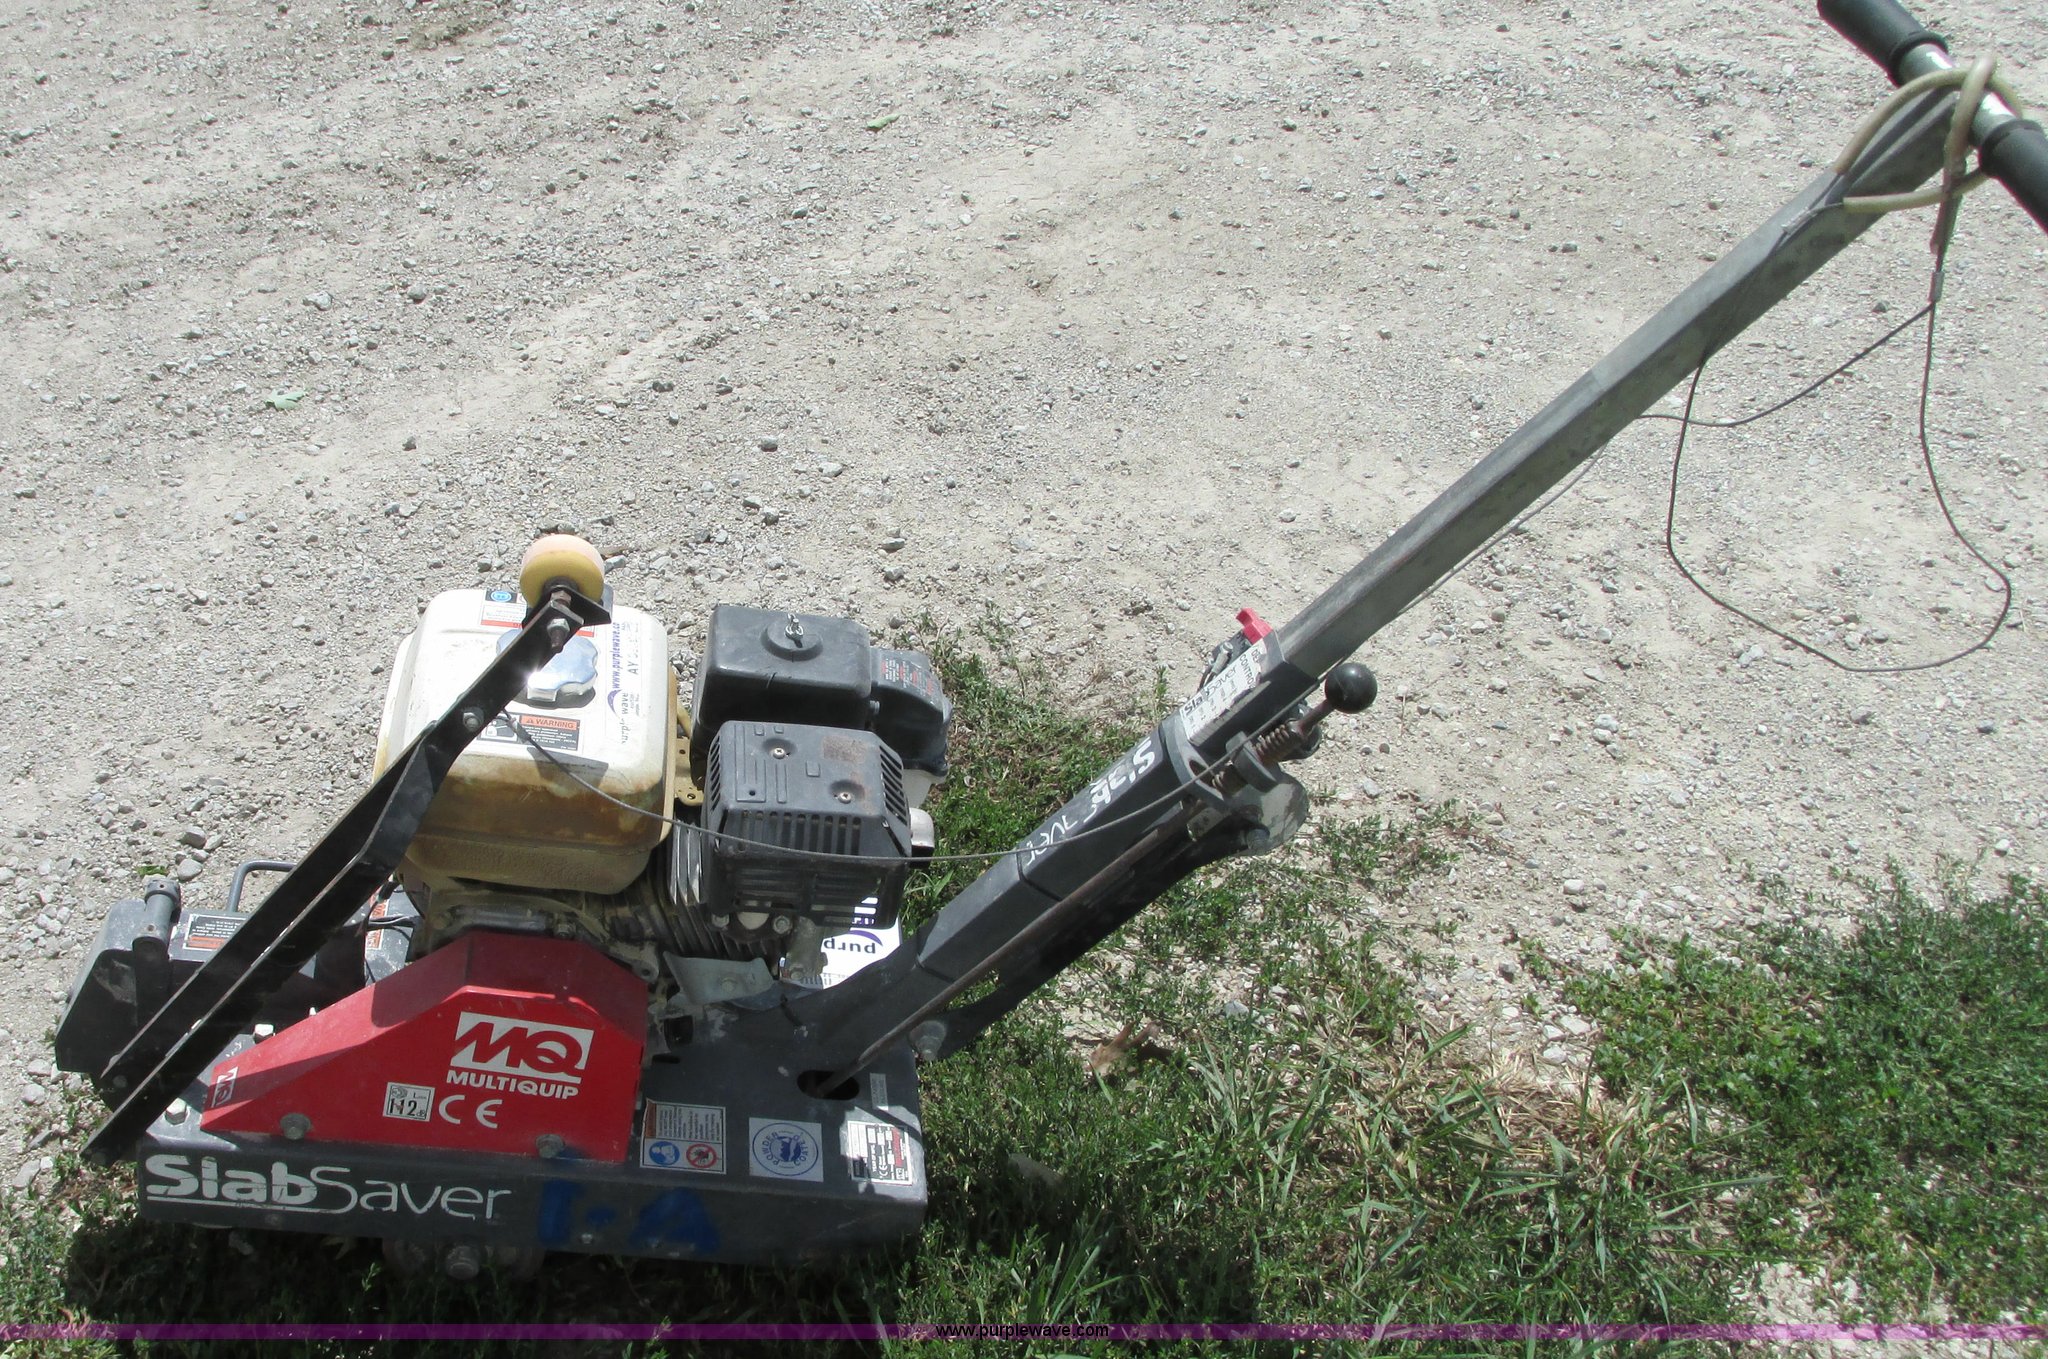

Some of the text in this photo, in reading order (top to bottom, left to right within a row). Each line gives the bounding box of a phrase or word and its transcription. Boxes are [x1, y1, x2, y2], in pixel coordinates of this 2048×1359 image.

[536, 718, 574, 729] WARNING
[450, 1016, 590, 1080] MQ
[446, 1069, 579, 1100] MULTIQUIP
[145, 1154, 512, 1219] SlabSaver
